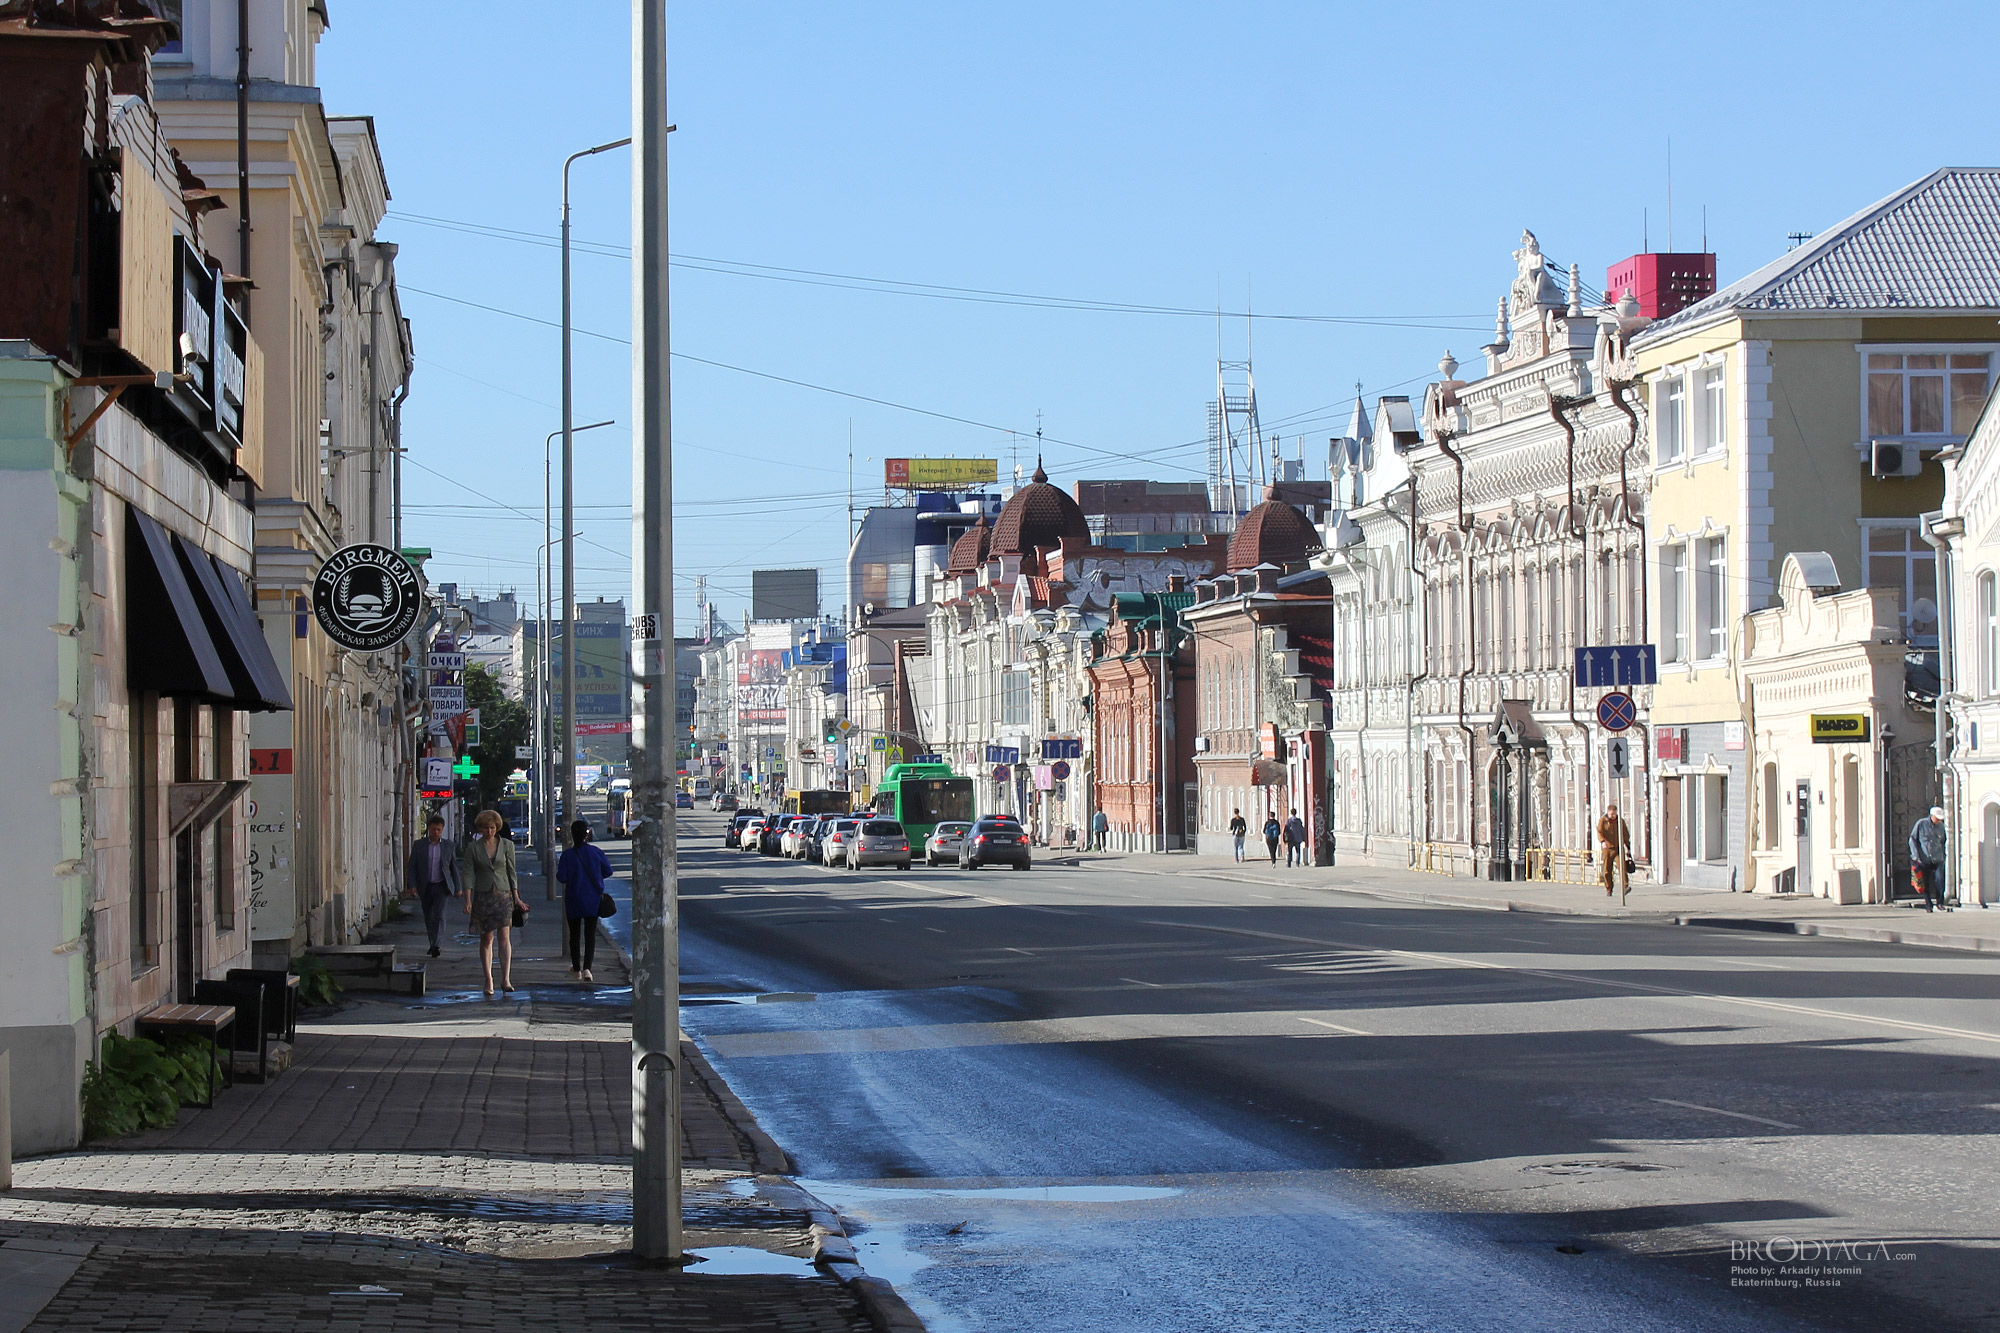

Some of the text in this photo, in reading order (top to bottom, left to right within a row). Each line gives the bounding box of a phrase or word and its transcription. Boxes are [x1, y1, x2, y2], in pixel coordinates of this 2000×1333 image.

[918, 467, 948, 475] Интернет
[320, 548, 415, 587] BURGMEN
[318, 605, 415, 646] ФЕРМЕРСКАЯ ЗАКУСОЧНАЯ
[631, 614, 656, 629] CUBS
[631, 627, 656, 640] CREW
[430, 656, 461, 666] ОЧКИ
[584, 683, 618, 692] УСПЕХА
[431, 700, 462, 710] ТОВАРЫ
[1816, 719, 1859, 732] HARD
